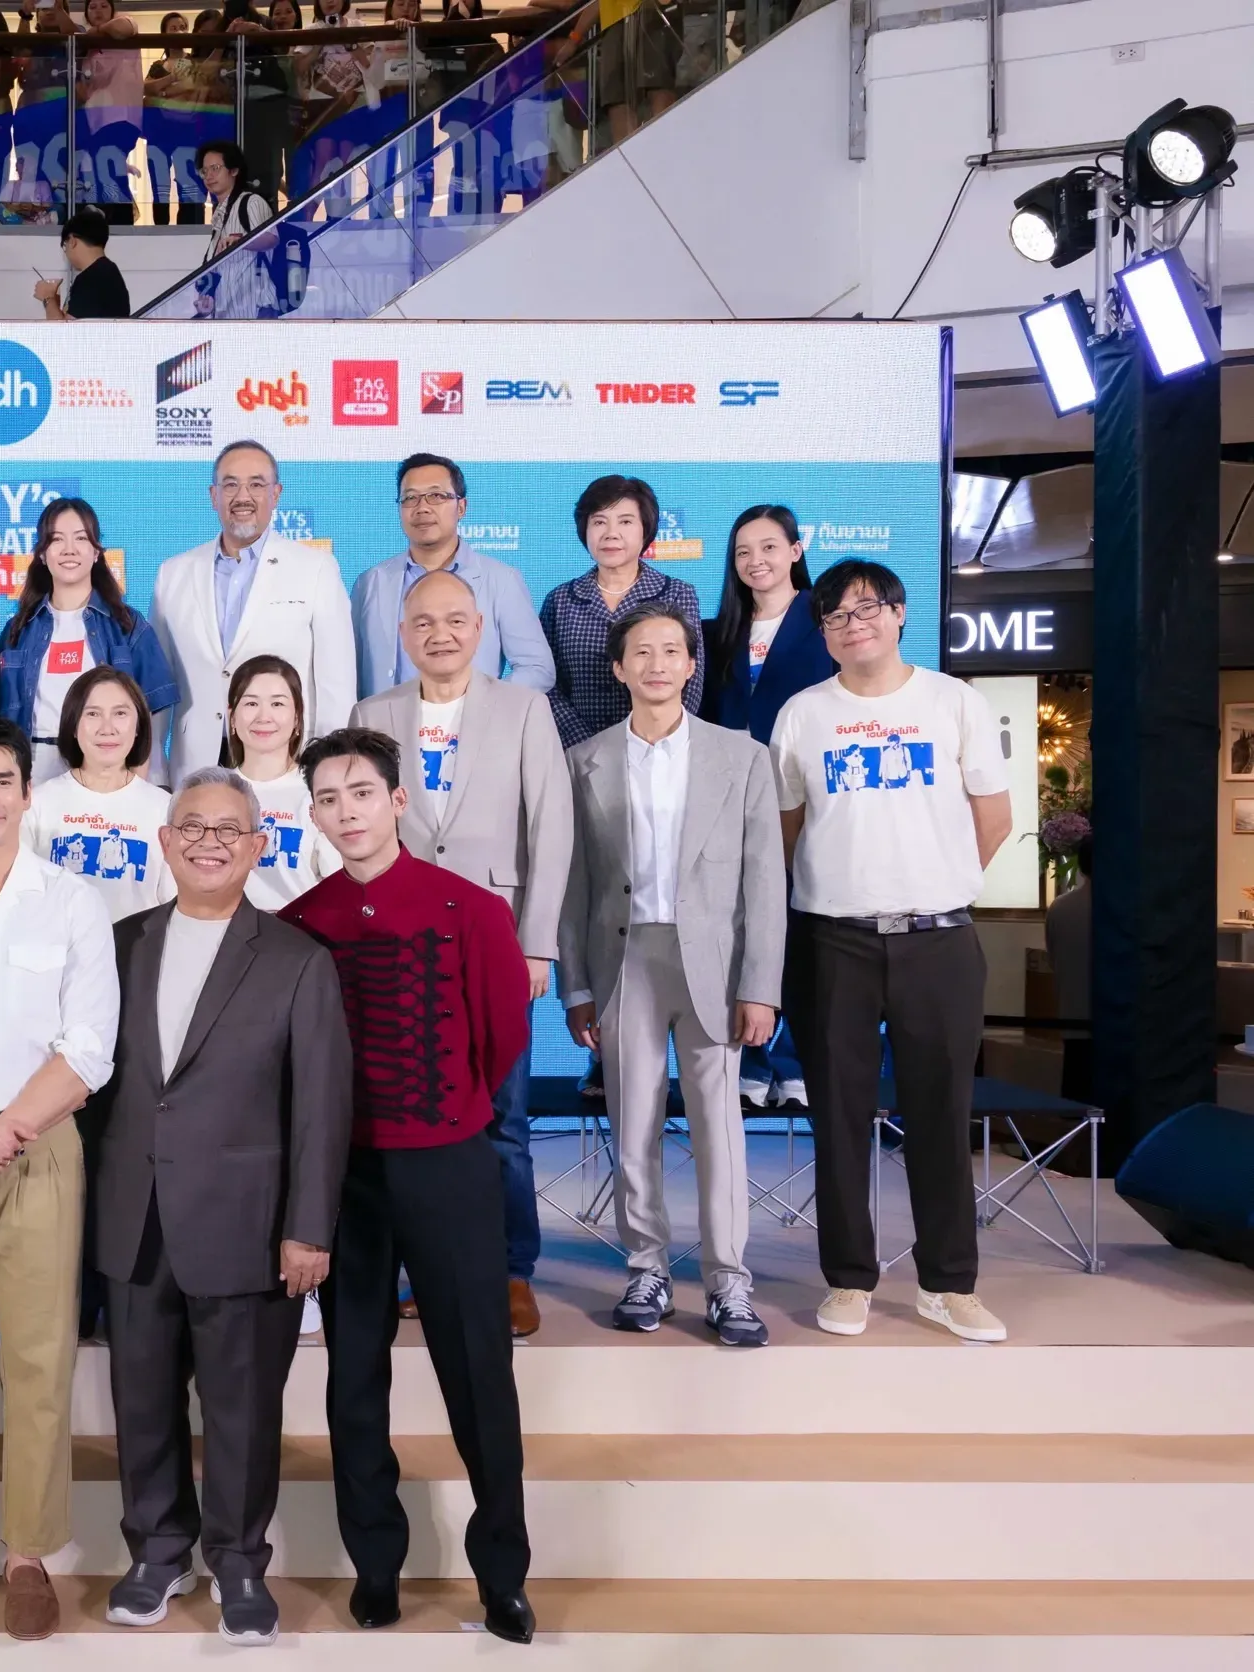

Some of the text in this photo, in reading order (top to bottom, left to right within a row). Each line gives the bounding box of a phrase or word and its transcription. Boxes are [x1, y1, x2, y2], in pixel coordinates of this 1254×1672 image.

[354, 378, 385, 390] TAG
[486, 380, 571, 400] BEM
[596, 384, 695, 403] TINDER
[720, 381, 779, 406] SF
[156, 408, 212, 418] SONY
